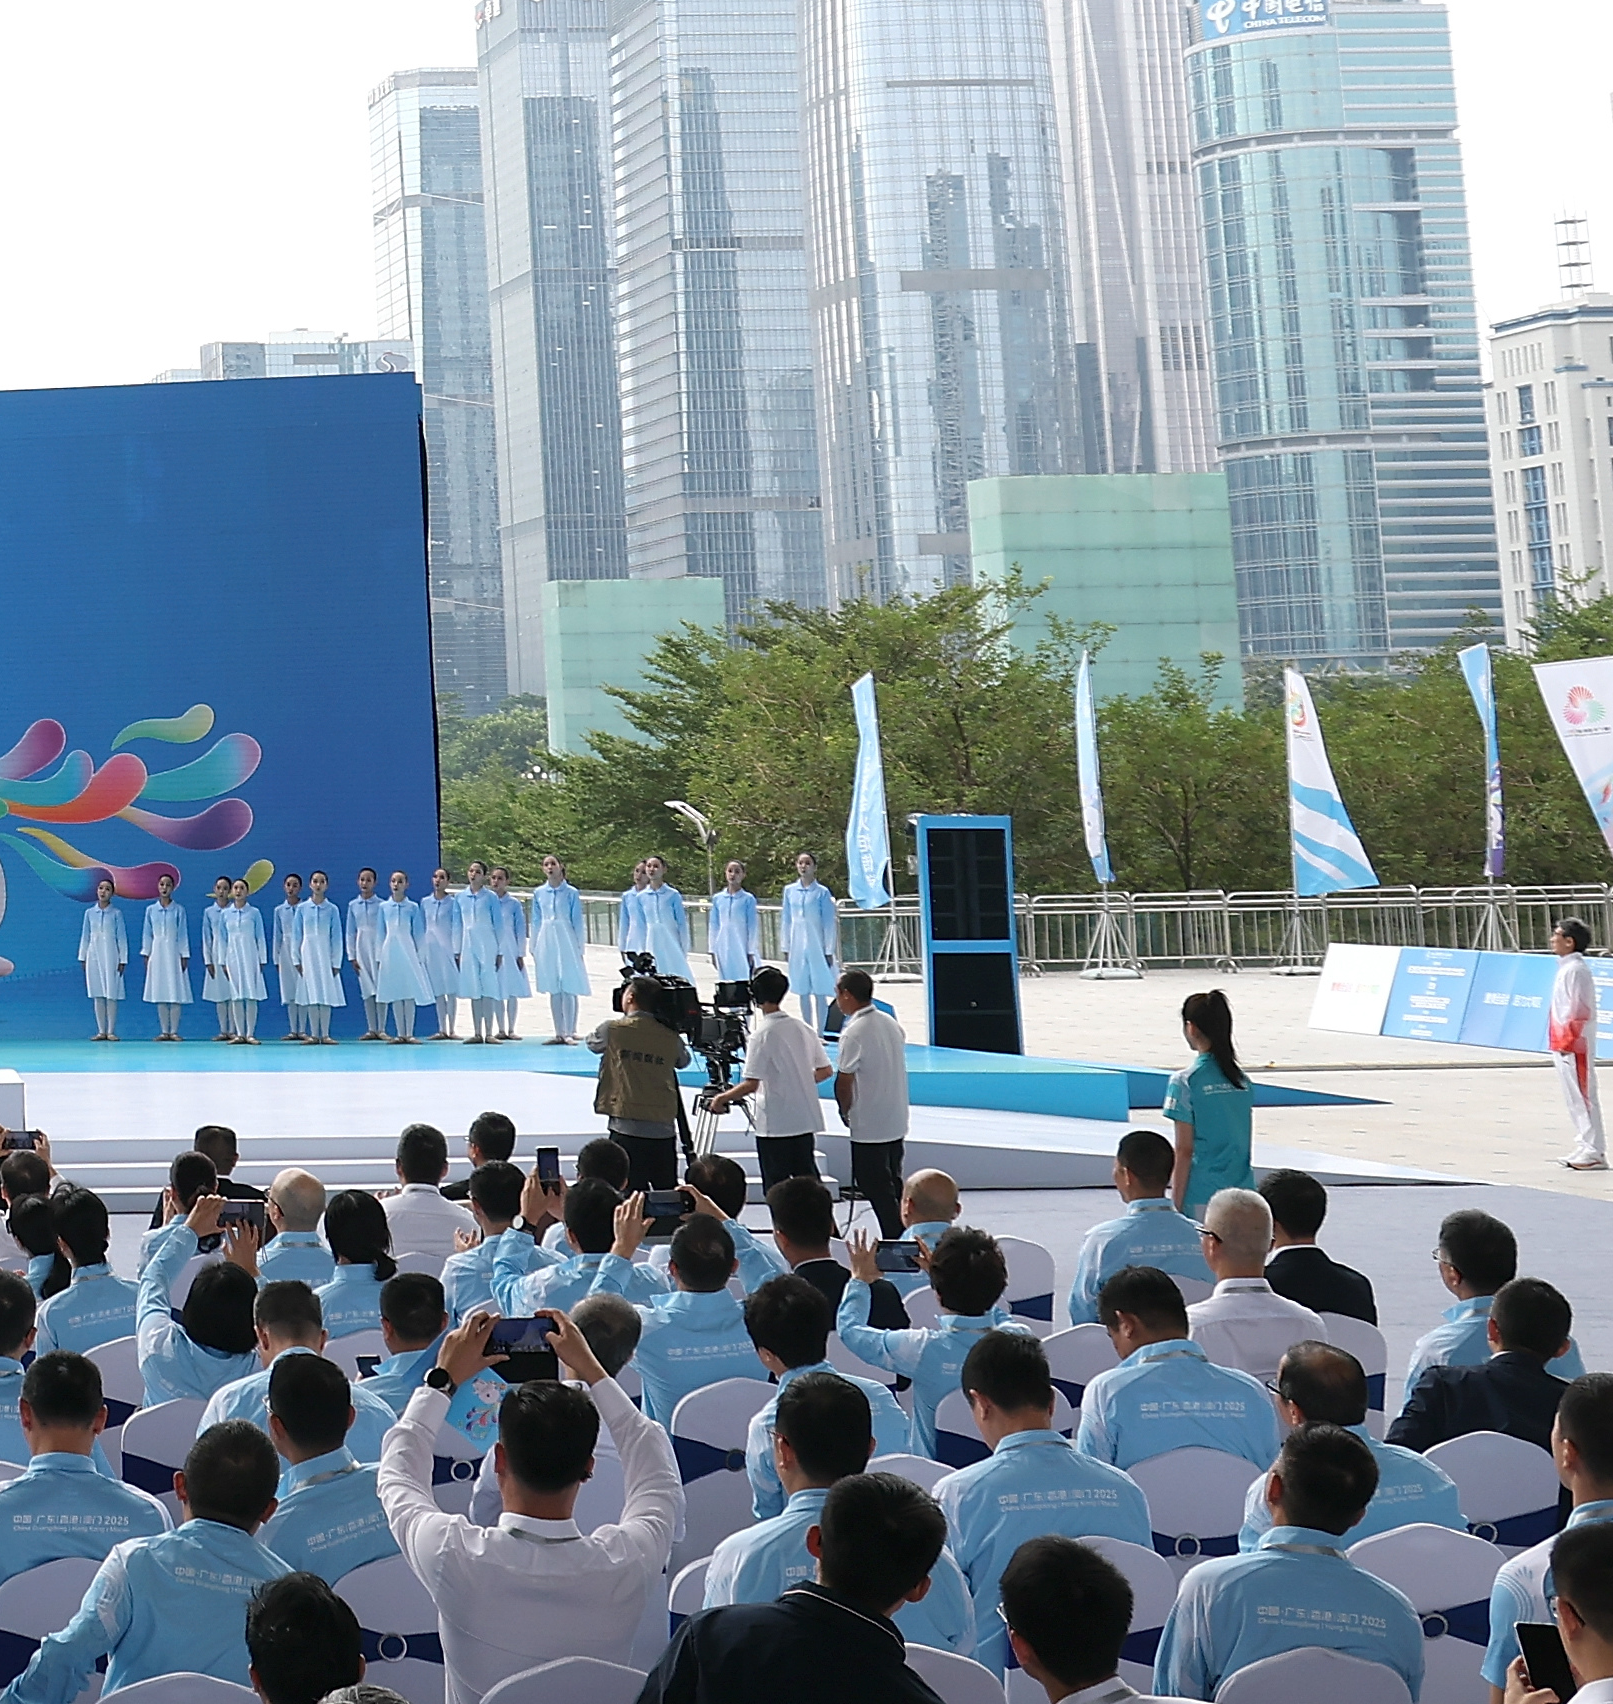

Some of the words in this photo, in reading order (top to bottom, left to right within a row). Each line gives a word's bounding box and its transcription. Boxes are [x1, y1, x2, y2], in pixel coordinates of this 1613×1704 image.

[1243, 19, 1278, 29] CHINA
[1278, 14, 1326, 25] TELECOM
[1224, 1401, 1245, 1411] 2025
[1093, 1489, 1118, 1500] 2025
[104, 1516, 129, 1526] 2025
[1361, 1614, 1386, 1629] 2025
